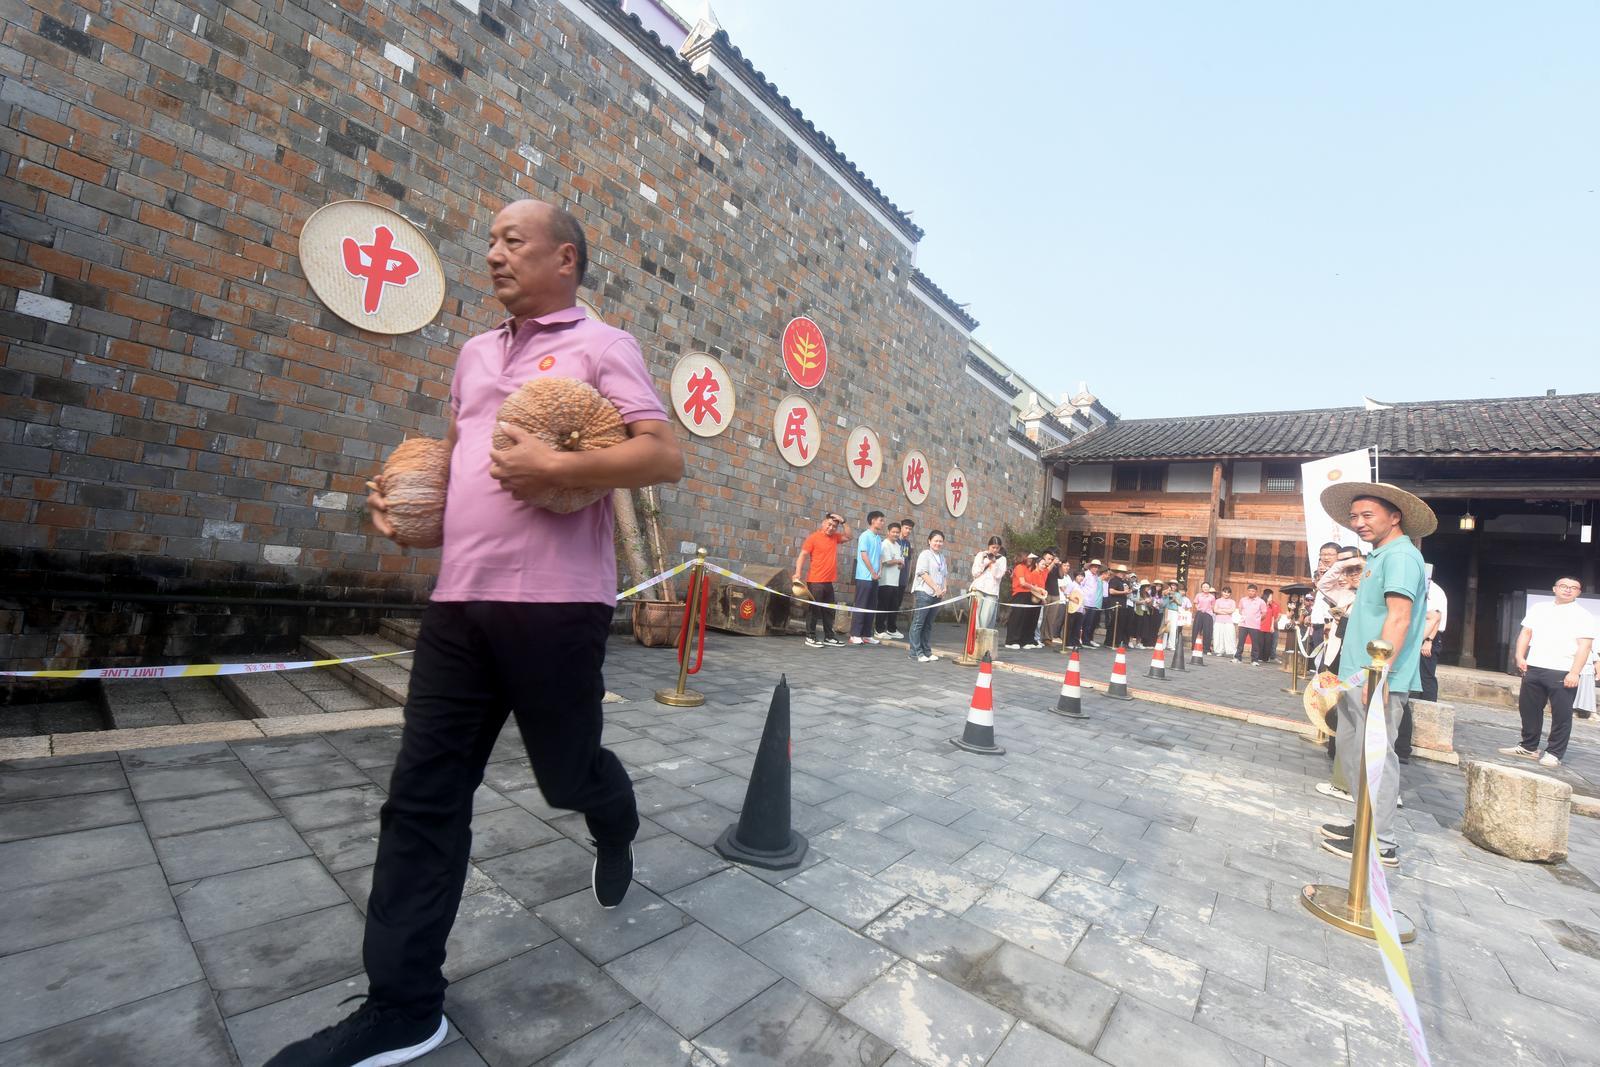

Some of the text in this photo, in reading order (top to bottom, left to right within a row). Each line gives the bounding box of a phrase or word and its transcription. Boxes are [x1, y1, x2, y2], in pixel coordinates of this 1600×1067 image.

[343, 226, 964, 510] 中 农 民 丰 收 节
[100, 667, 165, 678] LIMIT LINE
